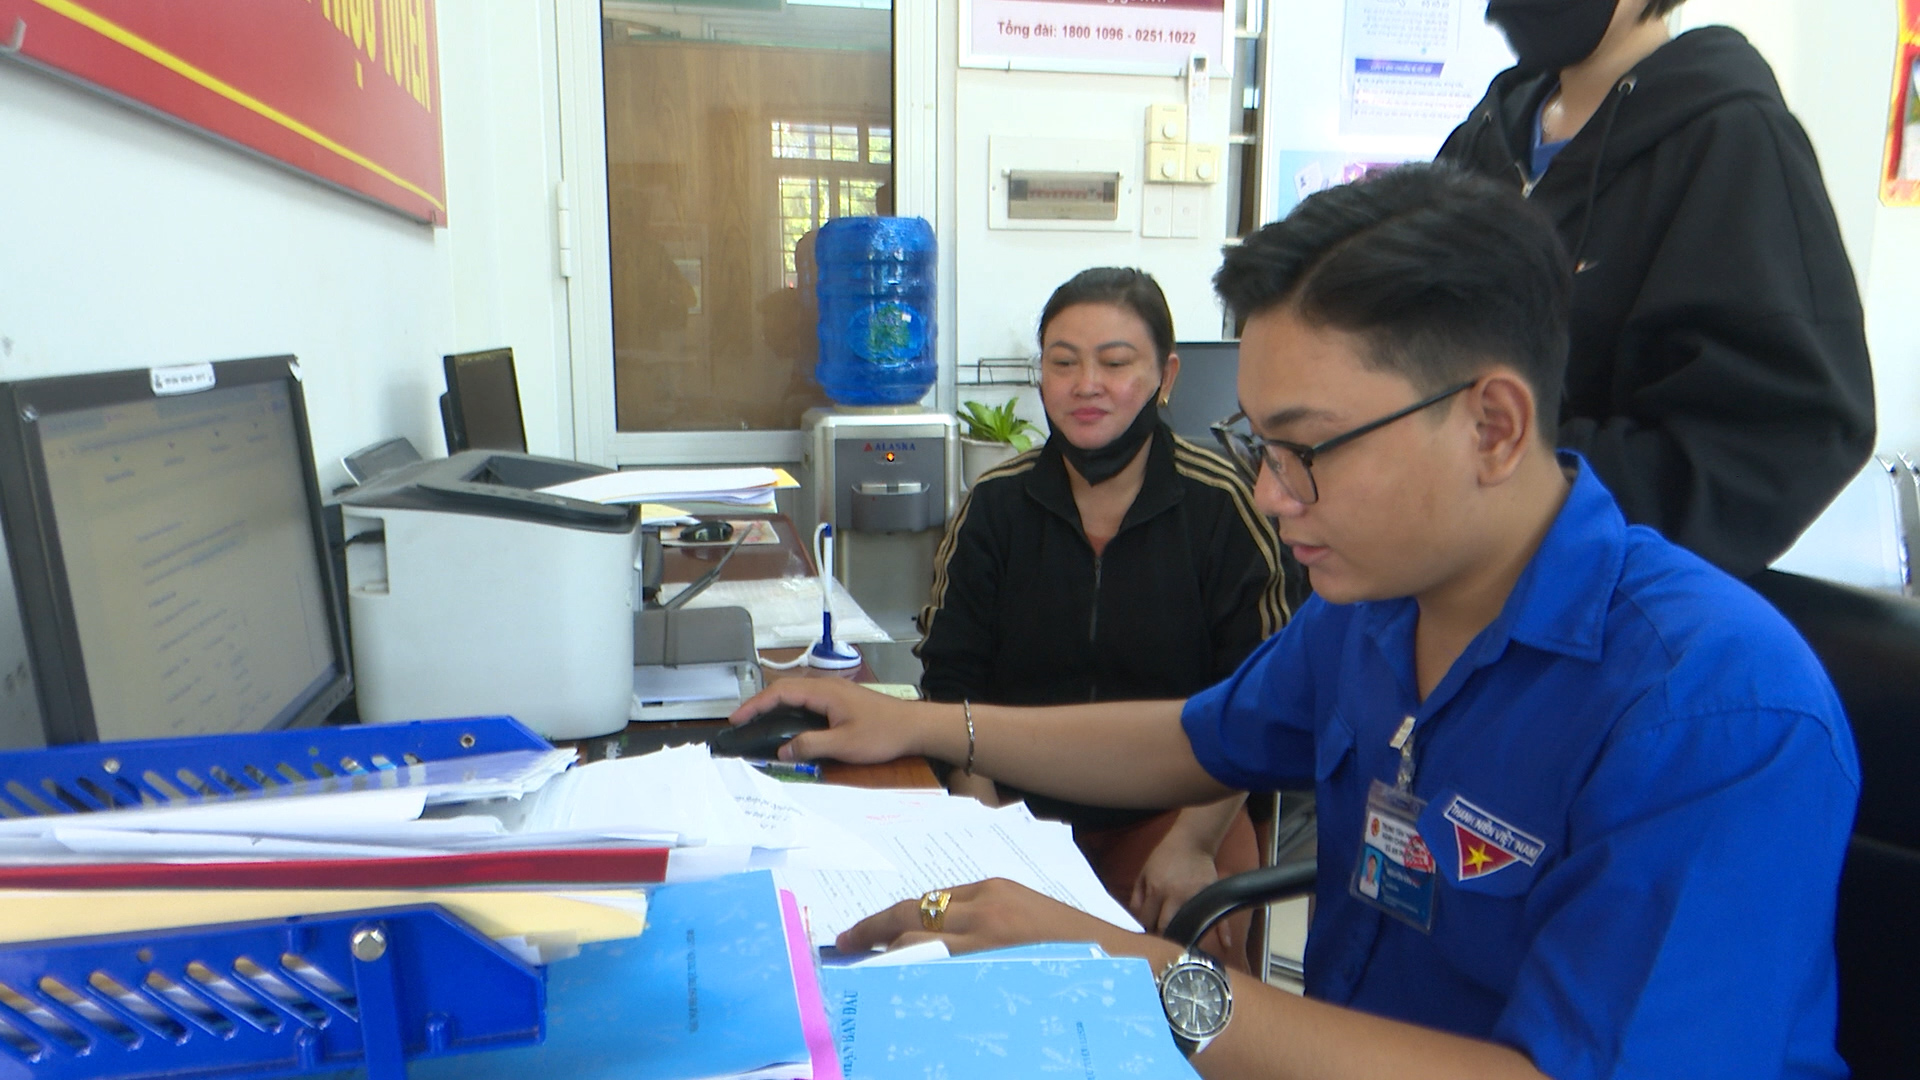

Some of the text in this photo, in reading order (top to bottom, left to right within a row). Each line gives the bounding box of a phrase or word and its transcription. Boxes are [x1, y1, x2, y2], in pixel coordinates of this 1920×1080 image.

[998, 19, 1030, 39] Tổng
[1034, 24, 1058, 38] đài:
[1063, 25, 1090, 39] 1800
[1096, 27, 1124, 41] 1096
[1135, 28, 1197, 45] 0251.1022
[875, 442, 916, 452] ALASKA
[1514, 840, 1540, 859] NAM
